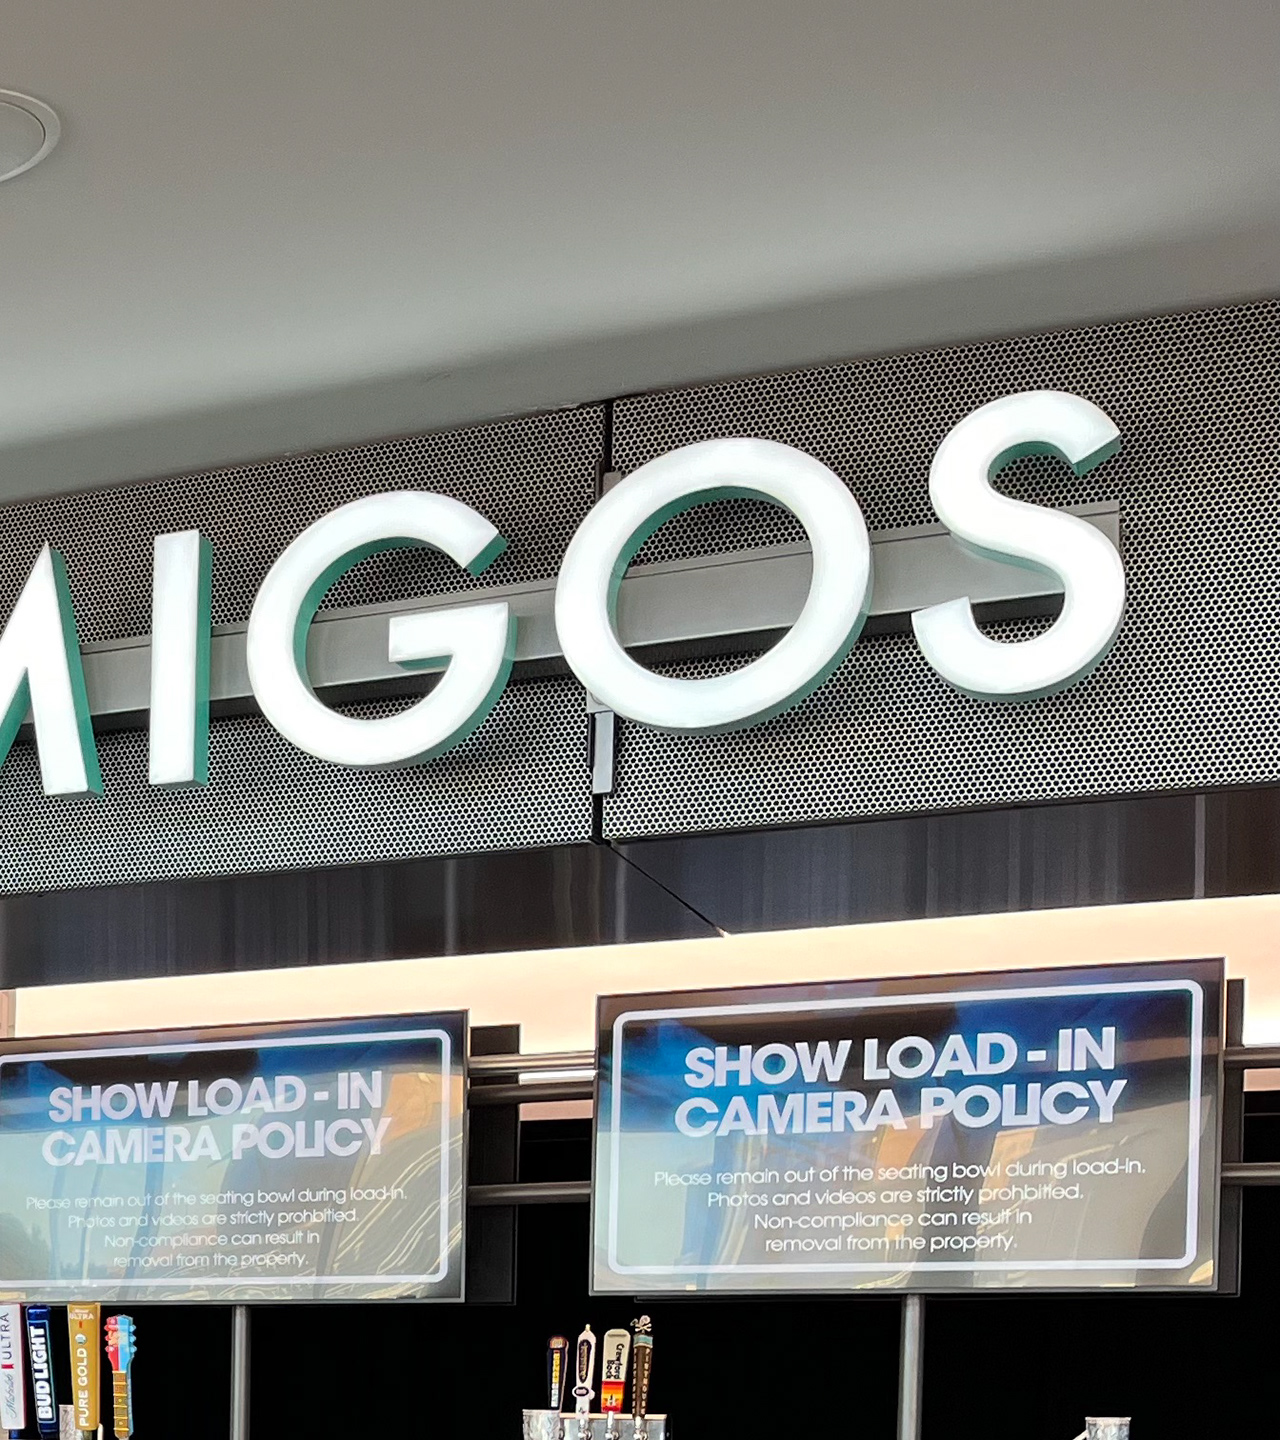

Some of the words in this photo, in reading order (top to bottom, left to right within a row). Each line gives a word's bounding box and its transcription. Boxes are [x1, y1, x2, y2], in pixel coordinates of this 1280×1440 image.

[685, 1040, 852, 1087] SHOW
[49, 1080, 178, 1122] SHOW
[674, 1089, 907, 1138] CAMERA
[919, 1079, 1127, 1129] POLICY
[42, 1124, 222, 1167] CAMERA
[231, 1116, 392, 1160] POLICY
[653, 1171, 712, 1186] Please
[716, 1169, 779, 1184] remain
[784, 1167, 815, 1183] out
[819, 1166, 839, 1181] of
[842, 1165, 874, 1181] the
[878, 1163, 948, 1182] seating
[952, 1161, 1001, 1178] bowl
[1004, 1160, 1067, 1178] during
[1072, 1157, 1146, 1174] load-in.
[26, 1196, 71, 1209] Please
[74, 1194, 124, 1208] remain
[127, 1193, 151, 1207] out
[154, 1192, 169, 1206] of
[172, 1192, 197, 1205] the
[199, 1190, 254, 1206] seating
[257, 1188, 295, 1203] bowl
[297, 1187, 346, 1204] during
[350, 1185, 407, 1200] load-in.
[707, 1192, 768, 1207] Photos
[772, 1190, 810, 1206] and
[815, 1189, 876, 1204] videos
[879, 1190, 913, 1203] are
[916, 1186, 974, 1204] strictly
[68, 1214, 115, 1228] Photos
[118, 1213, 148, 1227] and
[151, 1212, 199, 1226] videos
[201, 1213, 227, 1225] are
[230, 1210, 274, 1226] strictly
[754, 1212, 913, 1230] Non-compliance
[917, 1212, 957, 1226] can
[961, 1208, 1011, 1224] result
[1015, 1208, 1032, 1223] in
[104, 1233, 228, 1248] Non-compliance
[230, 1233, 262, 1245] can
[265, 1230, 303, 1244] result
[306, 1230, 320, 1243] in
[765, 1236, 842, 1252] removal
[846, 1235, 889, 1250] from
[894, 1234, 926, 1249] the
[930, 1232, 1016, 1252] property.
[113, 1254, 172, 1268] removal
[176, 1253, 210, 1267] from
[213, 1253, 237, 1266] the
[241, 1251, 308, 1268] property.
[0, 1313, 12, 1361] ULTRA
[30, 1326, 49, 1379] LIGHT
[77, 1348, 88, 1387] GOLD
[615, 1343, 625, 1380] Crawford
[35, 1380, 53, 1419] BUD
[78, 1390, 89, 1427] PURE
